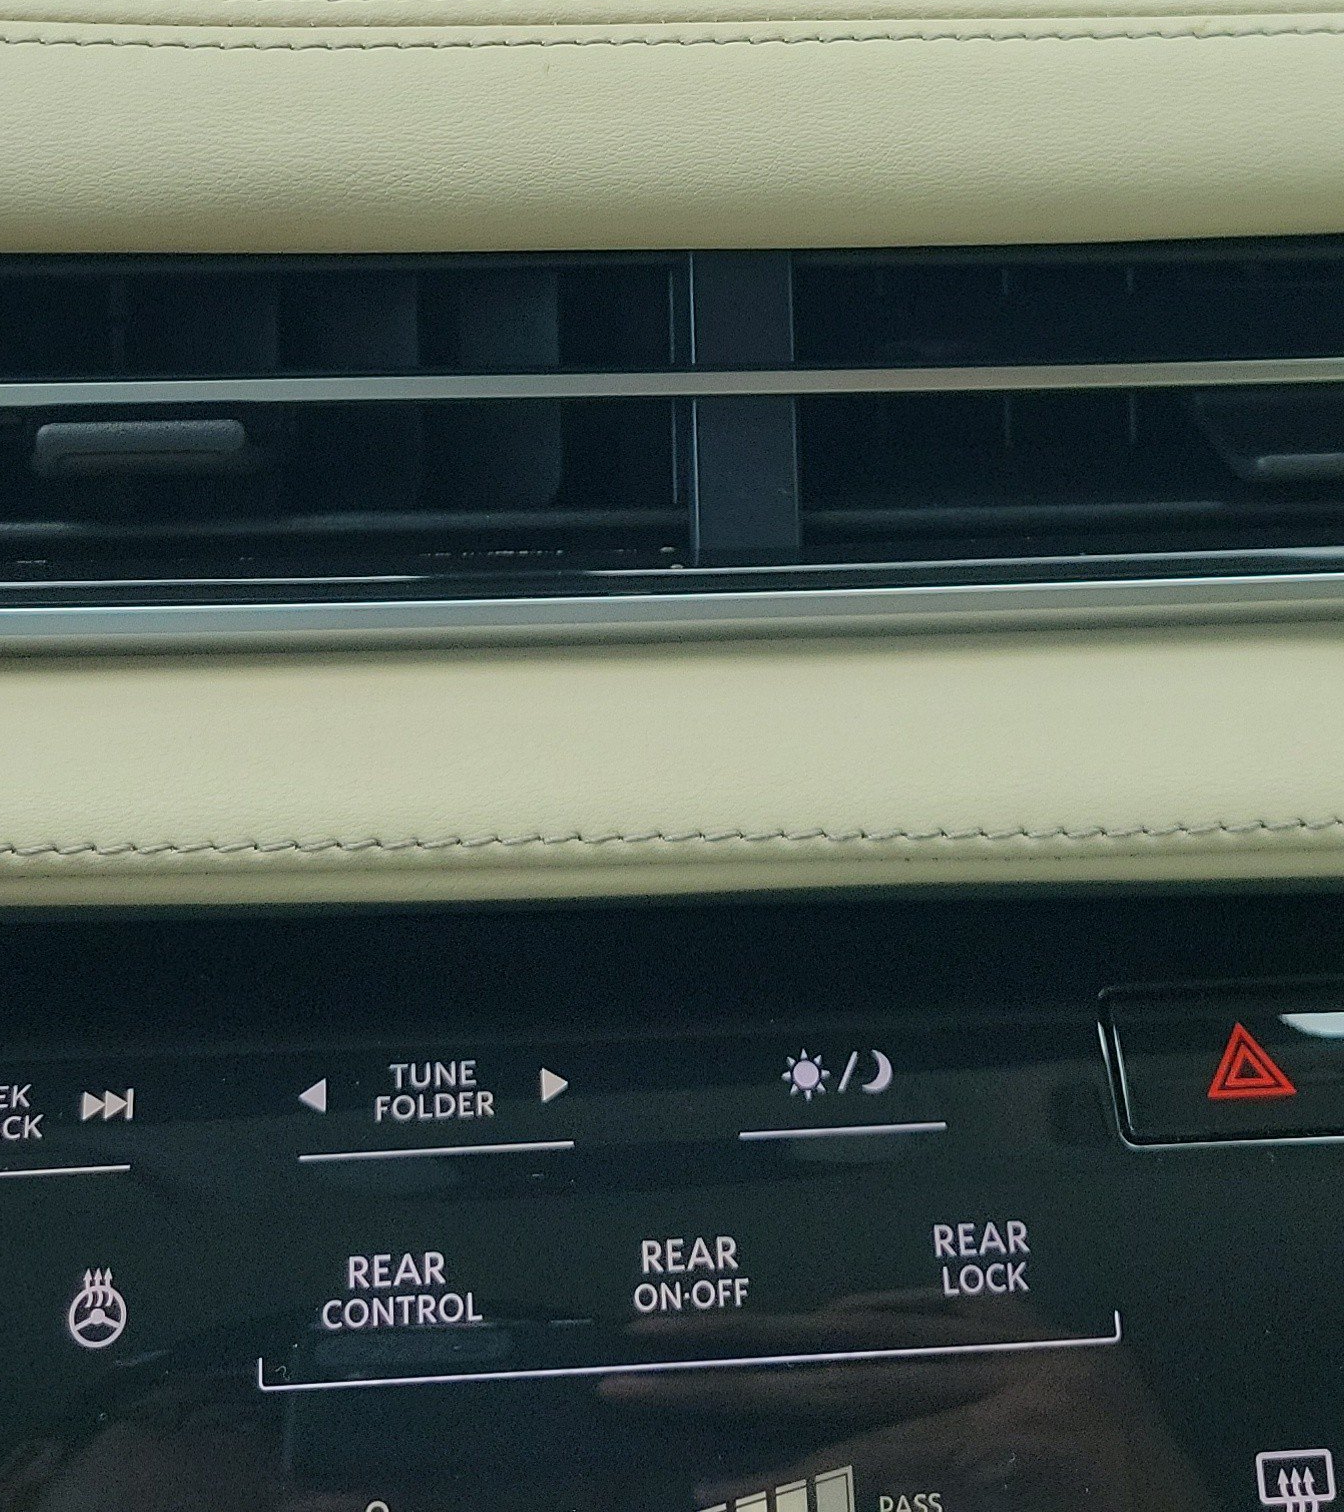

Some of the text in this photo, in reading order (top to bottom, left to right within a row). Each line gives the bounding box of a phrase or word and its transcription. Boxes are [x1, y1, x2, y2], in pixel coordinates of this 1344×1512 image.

[388, 1059, 478, 1090] TUNE
[374, 1090, 496, 1122] FOLDER
[641, 1236, 739, 1274] REAR
[933, 1220, 1031, 1258] REAR
[347, 1251, 447, 1289] REAR
[942, 1261, 1030, 1297] LOCK
[321, 1291, 484, 1330] CONTROL
